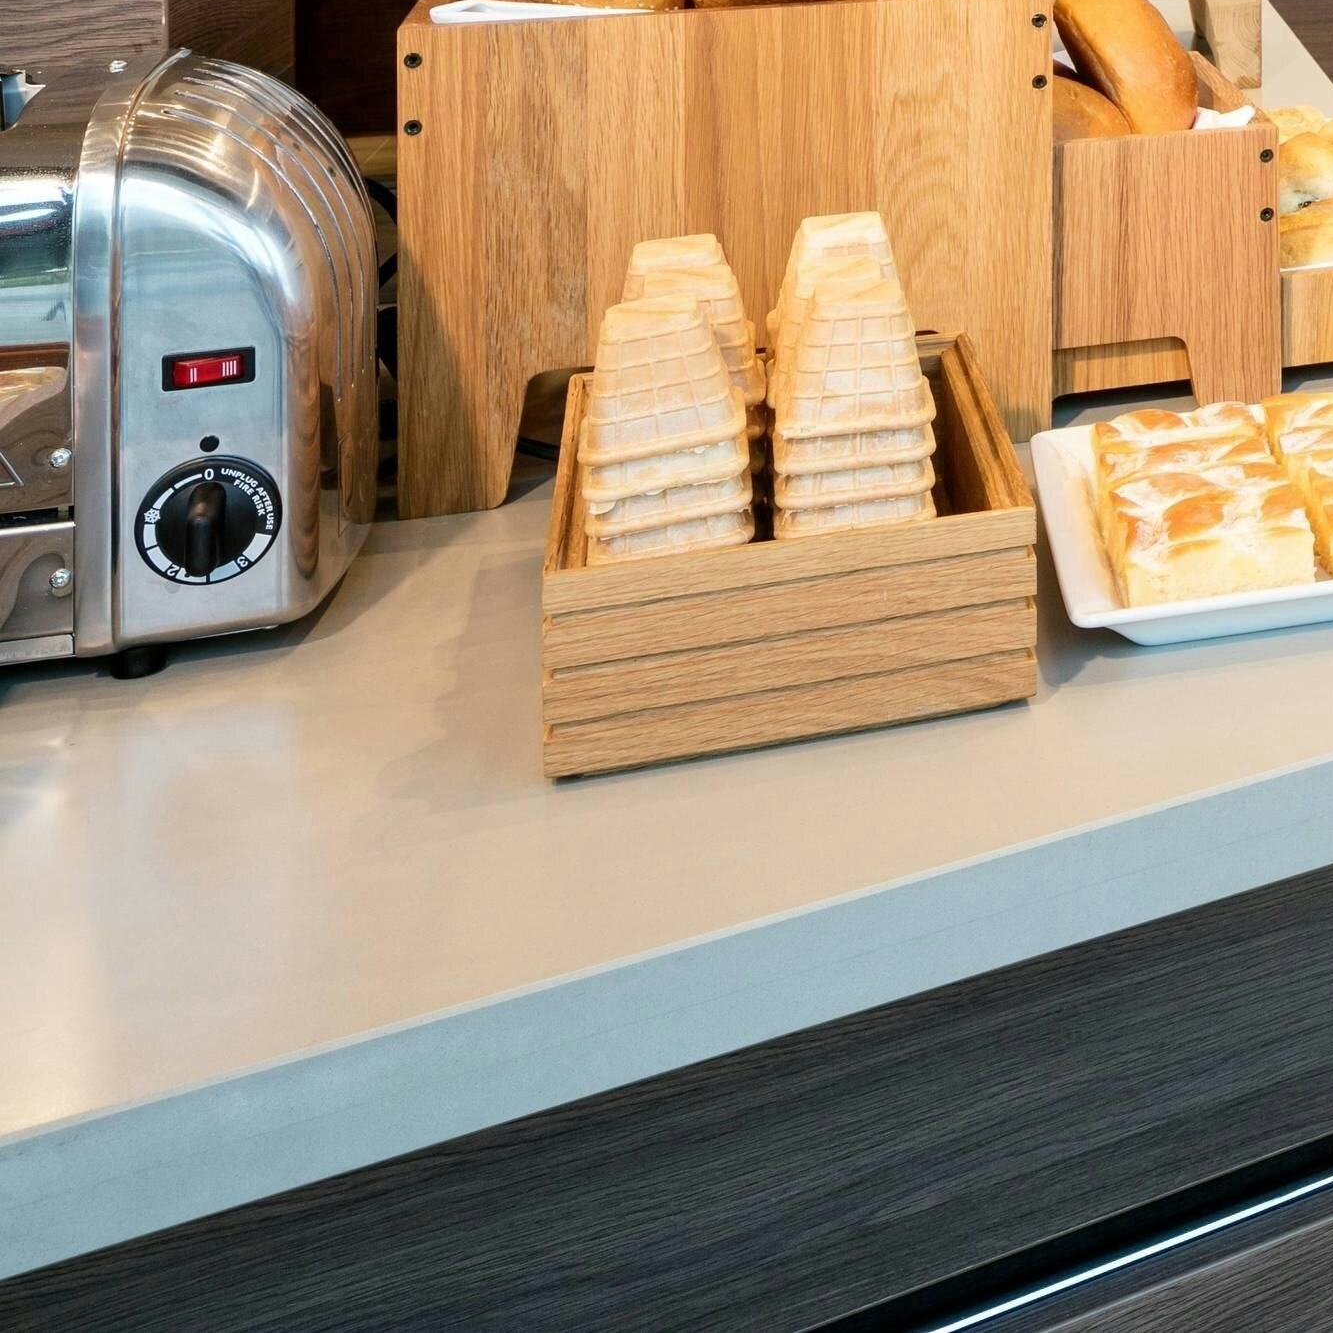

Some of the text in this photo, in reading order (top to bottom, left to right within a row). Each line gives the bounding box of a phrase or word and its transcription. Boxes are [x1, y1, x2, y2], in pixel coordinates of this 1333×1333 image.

[220, 467, 275, 531] UNPLUG AFTER USE
[233, 479, 266, 517] FIRE RISK
